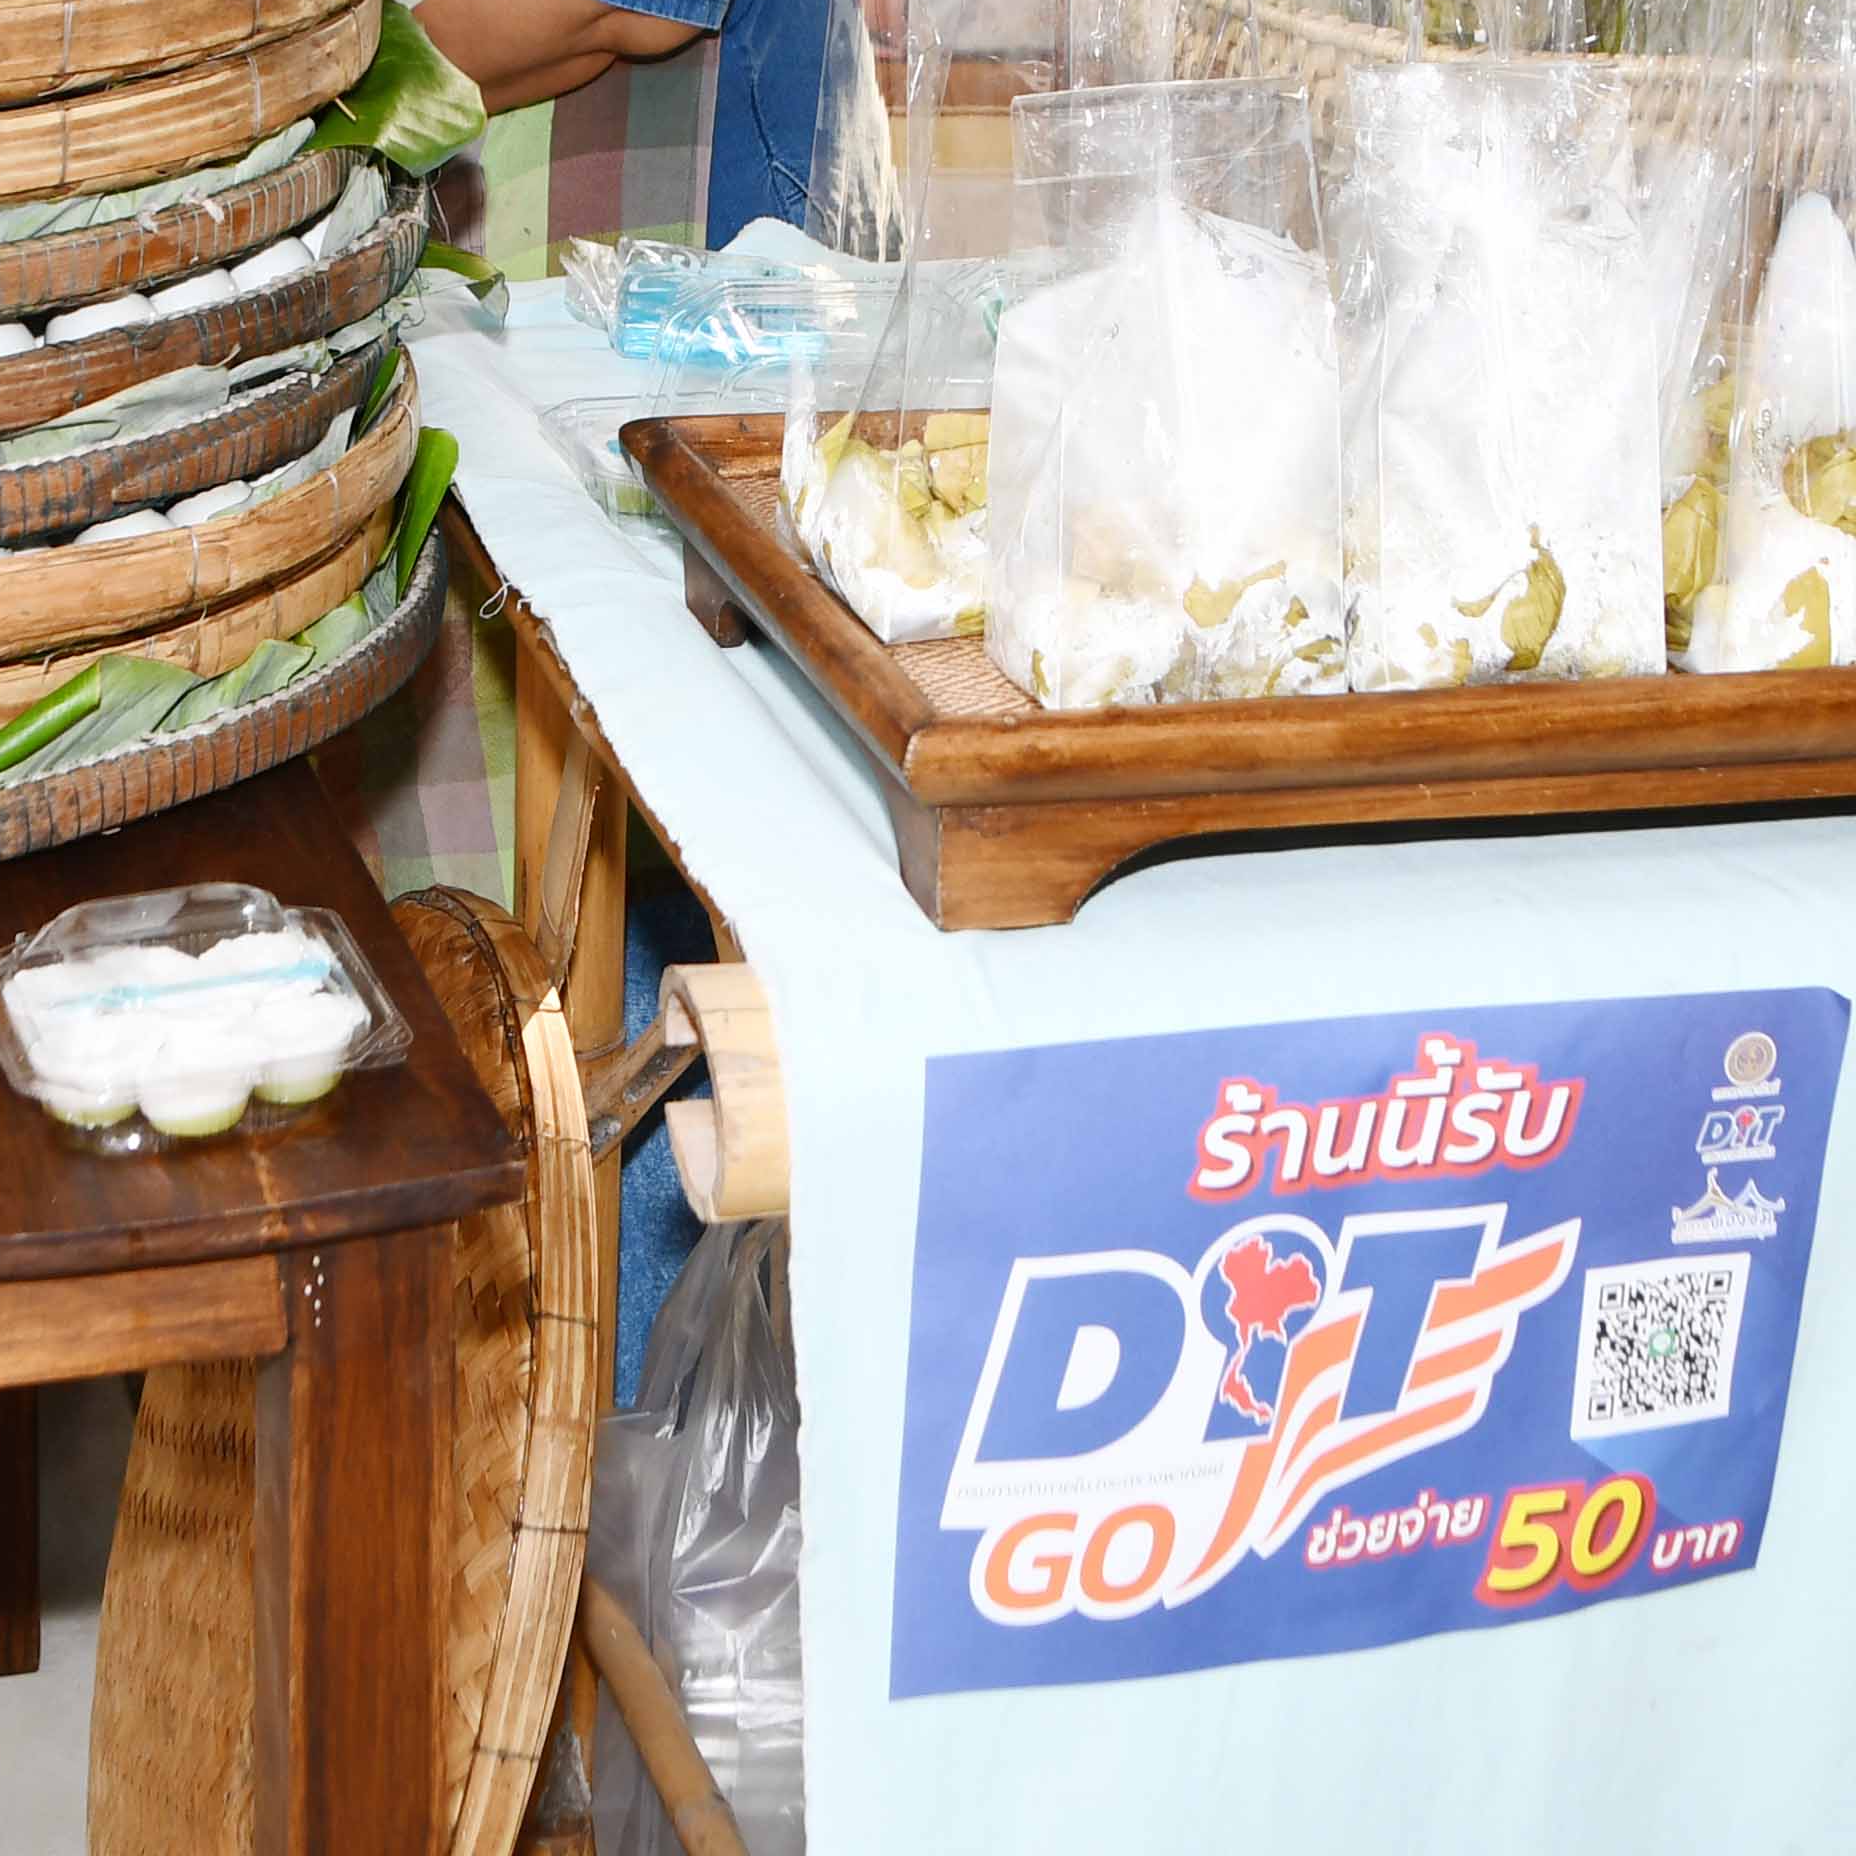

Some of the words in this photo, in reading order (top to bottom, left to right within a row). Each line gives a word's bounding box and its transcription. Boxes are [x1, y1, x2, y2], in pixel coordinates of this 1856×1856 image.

[1196, 1039, 1571, 1189] ร้านนี้รับ
[984, 1503, 1176, 1611] GO
[1306, 1490, 1485, 1564] ช่วยจ่าย
[1486, 1479, 1643, 1592] 50
[1651, 1519, 1739, 1569] บาท
